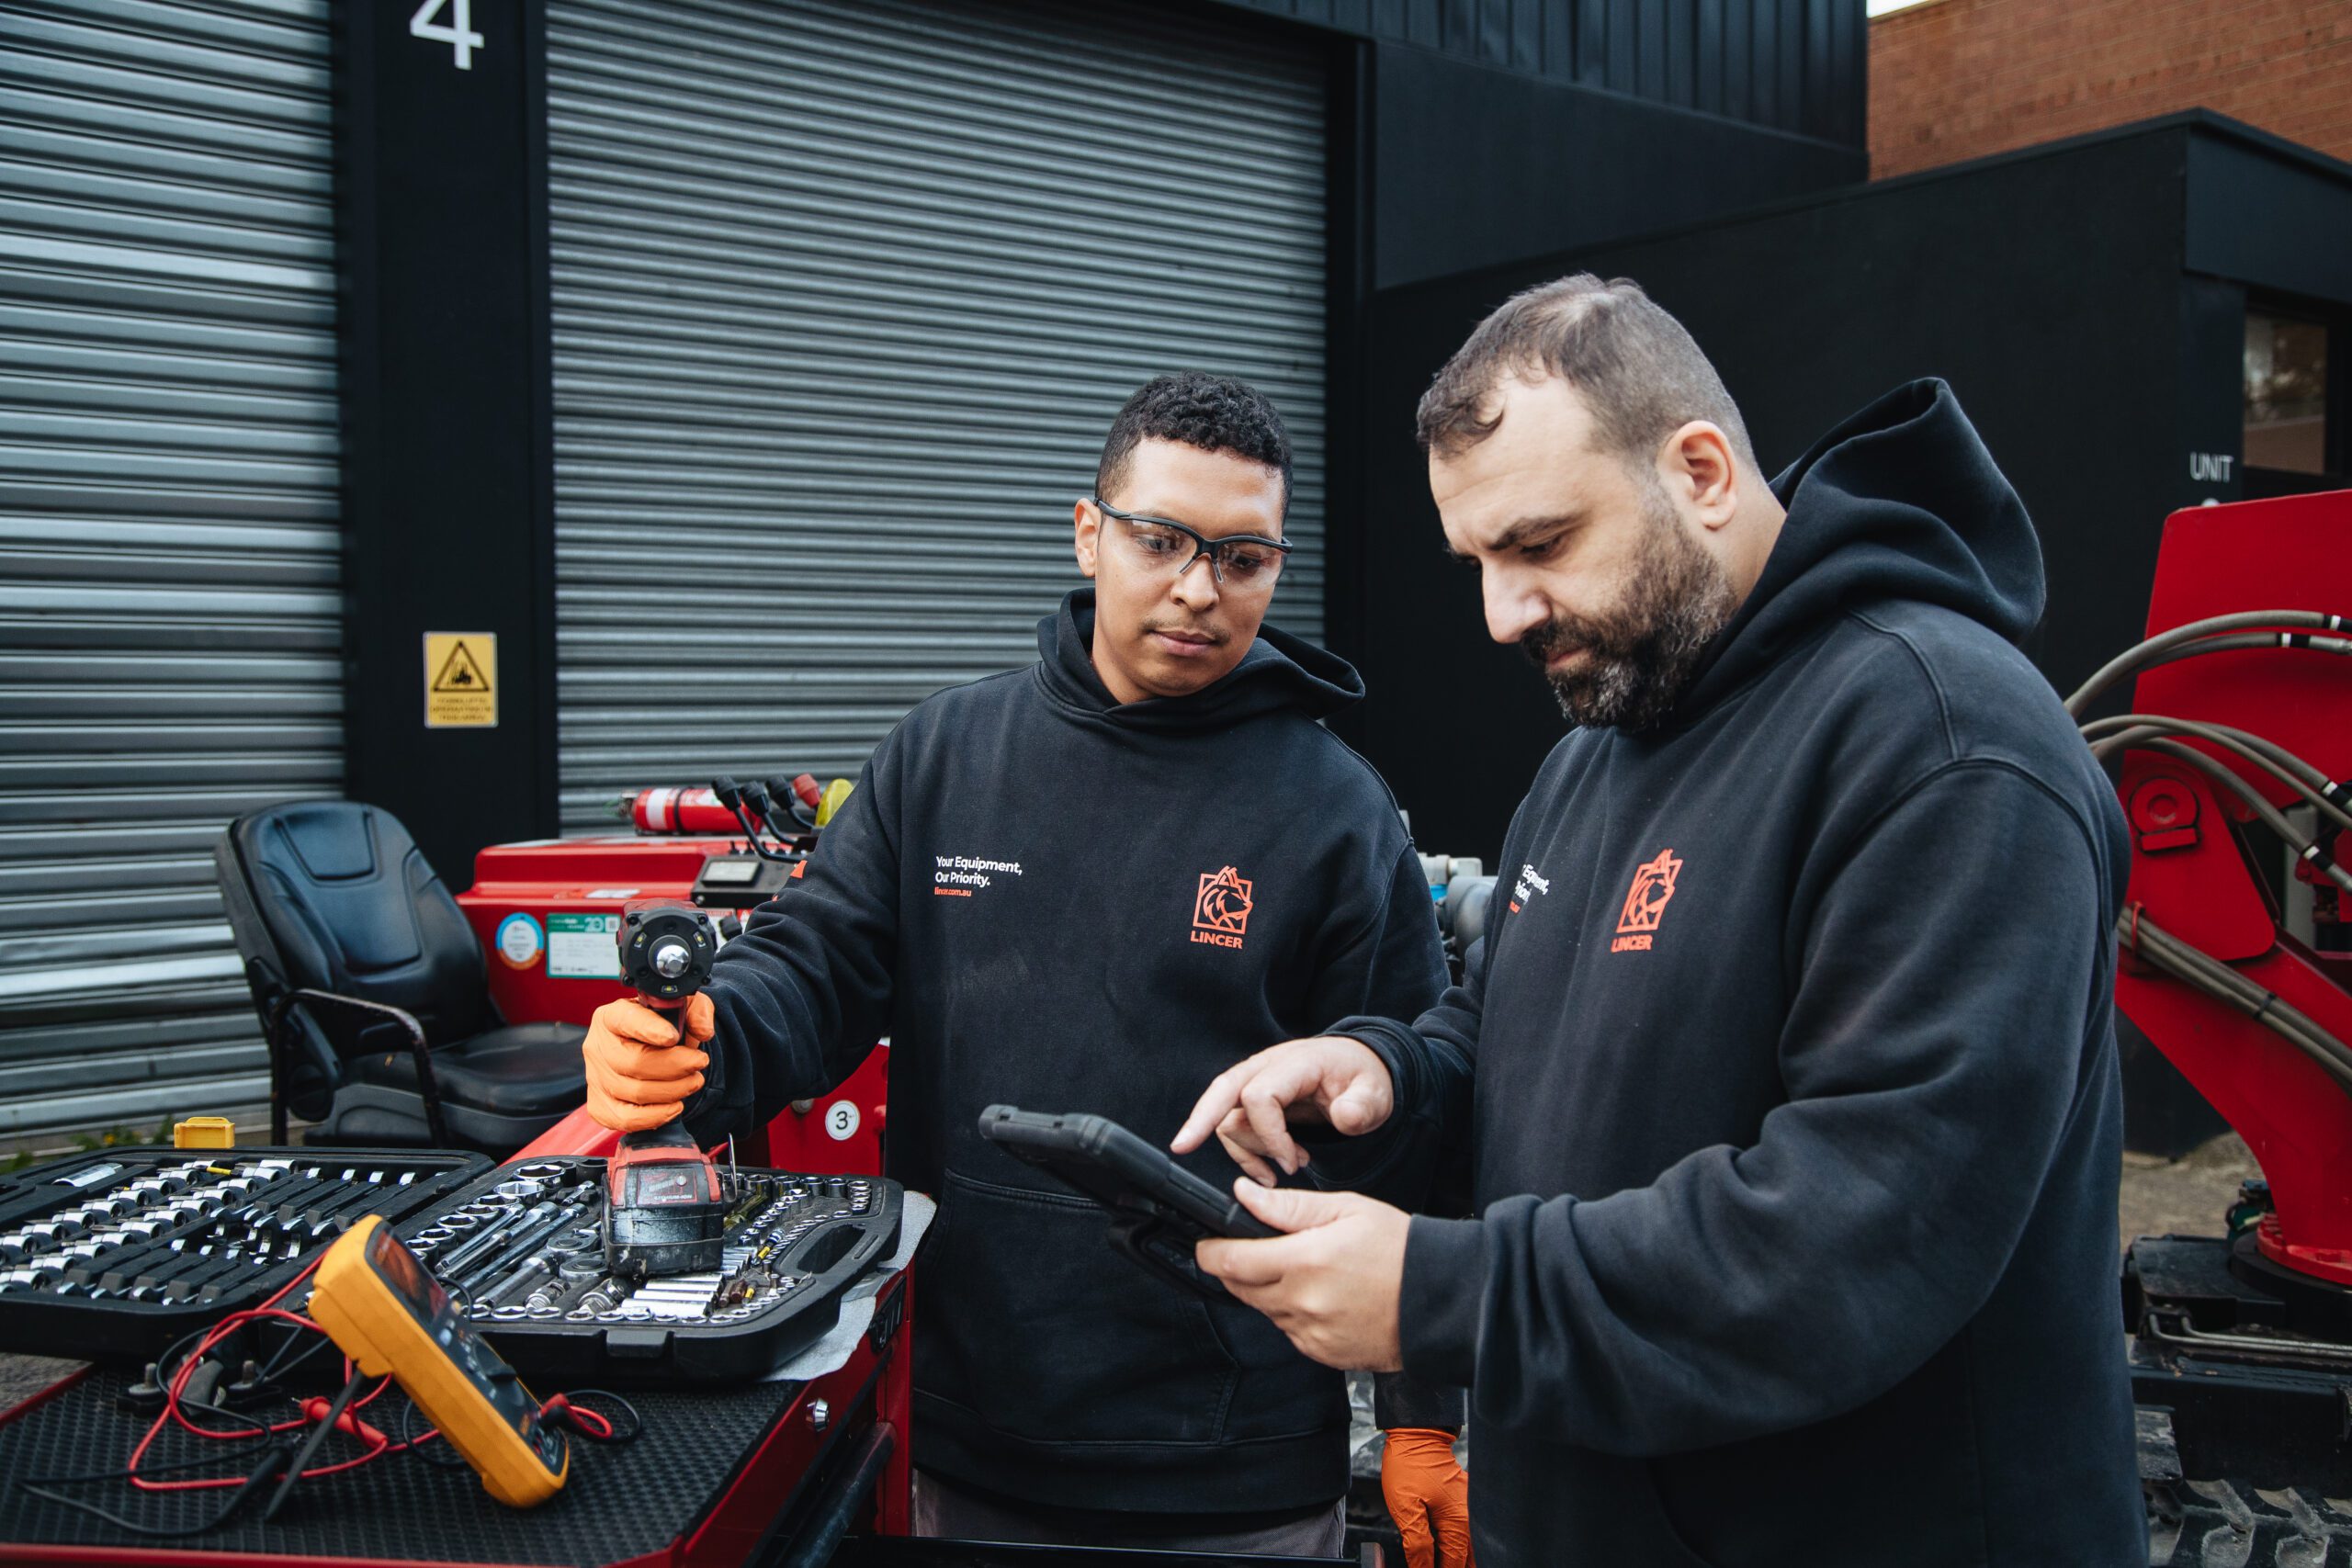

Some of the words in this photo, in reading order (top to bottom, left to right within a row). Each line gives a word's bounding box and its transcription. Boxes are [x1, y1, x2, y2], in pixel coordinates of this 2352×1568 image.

[410, 0, 484, 71] 4
[2189, 451, 2234, 483] UNIT
[935, 856, 954, 867] Your
[955, 856, 1023, 875] Equipment,
[934, 872, 949, 883] Our
[950, 871, 990, 888] Priority.
[1190, 930, 1243, 950] LINCER
[1611, 934, 1653, 953] LINCER
[835, 1111, 849, 1131] 3
